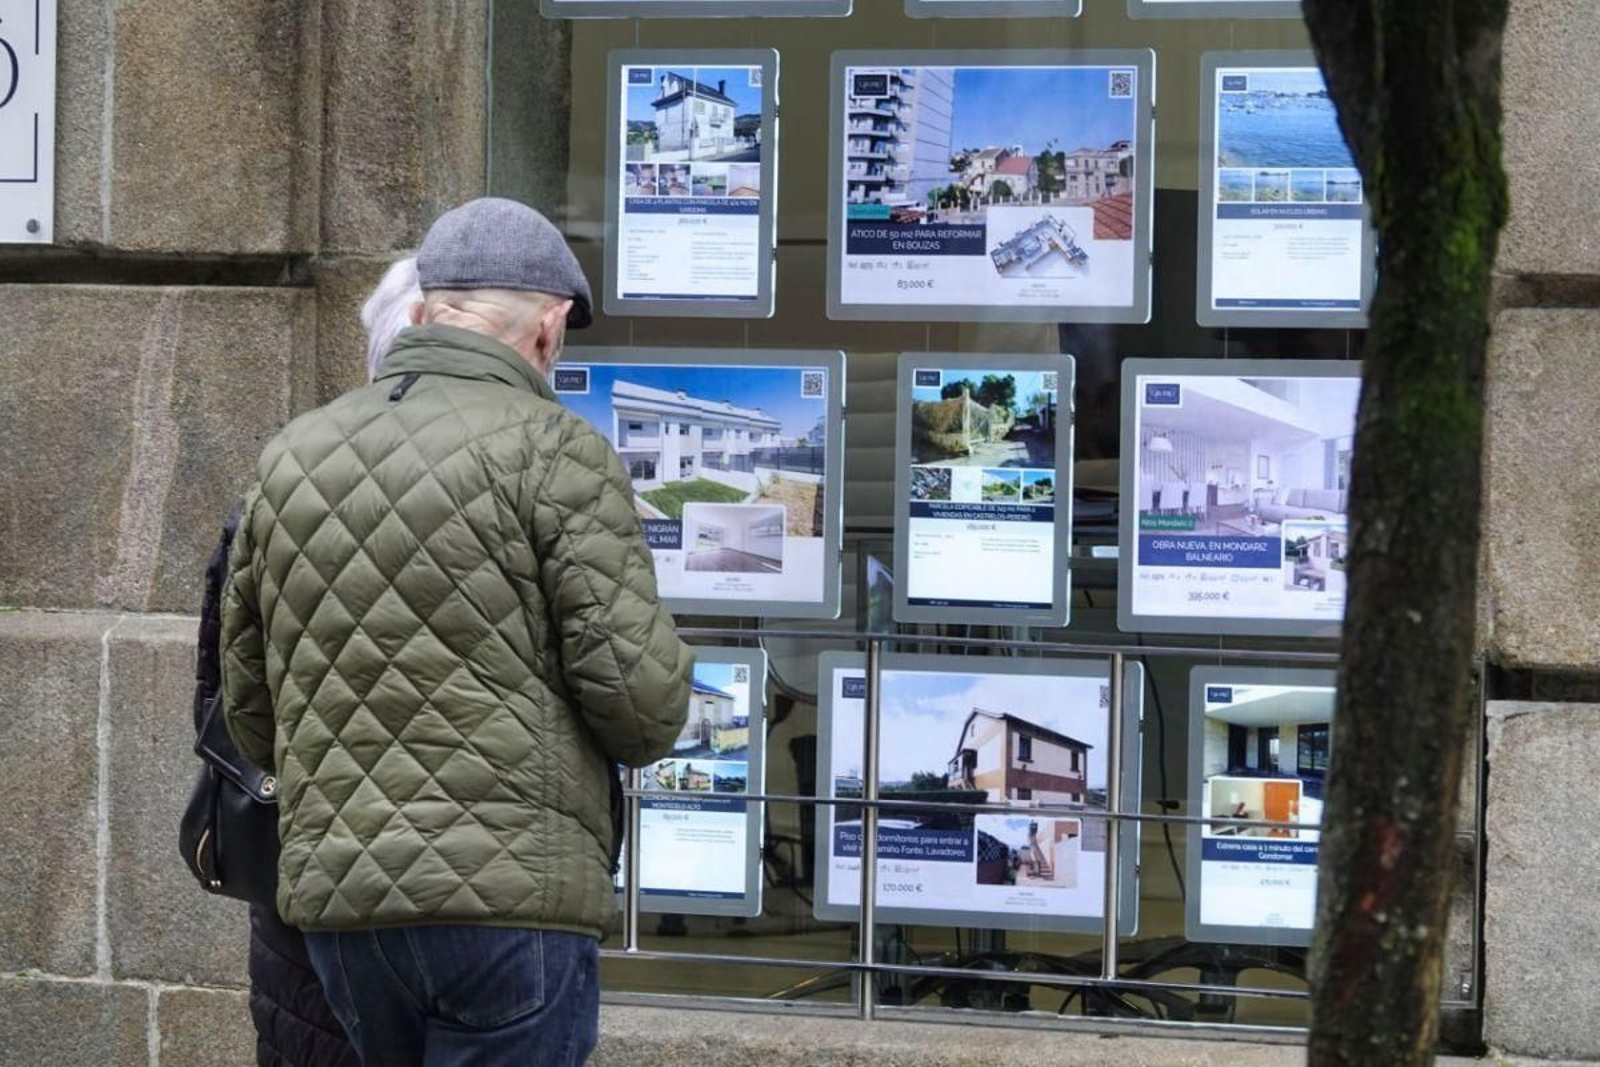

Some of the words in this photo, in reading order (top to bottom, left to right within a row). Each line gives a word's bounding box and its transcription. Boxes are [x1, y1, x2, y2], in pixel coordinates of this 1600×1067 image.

[876, 229, 889, 239] DE
[914, 229, 937, 239] PARA
[938, 229, 982, 239] REFORMAR
[892, 240, 905, 250] EN
[906, 240, 941, 250] BOUZAS
[927, 279, 935, 288] €
[660, 535, 678, 544] MAR
[1152, 540, 1175, 549] OBRA
[1208, 542, 1221, 551] EN
[1223, 542, 1268, 551] MONDARIZ
[1185, 553, 1234, 562] BALNEARIO
[1223, 591, 1230, 600] €
[839, 831, 856, 841] Piso
[920, 837, 938, 846] para
[915, 883, 924, 893] €
